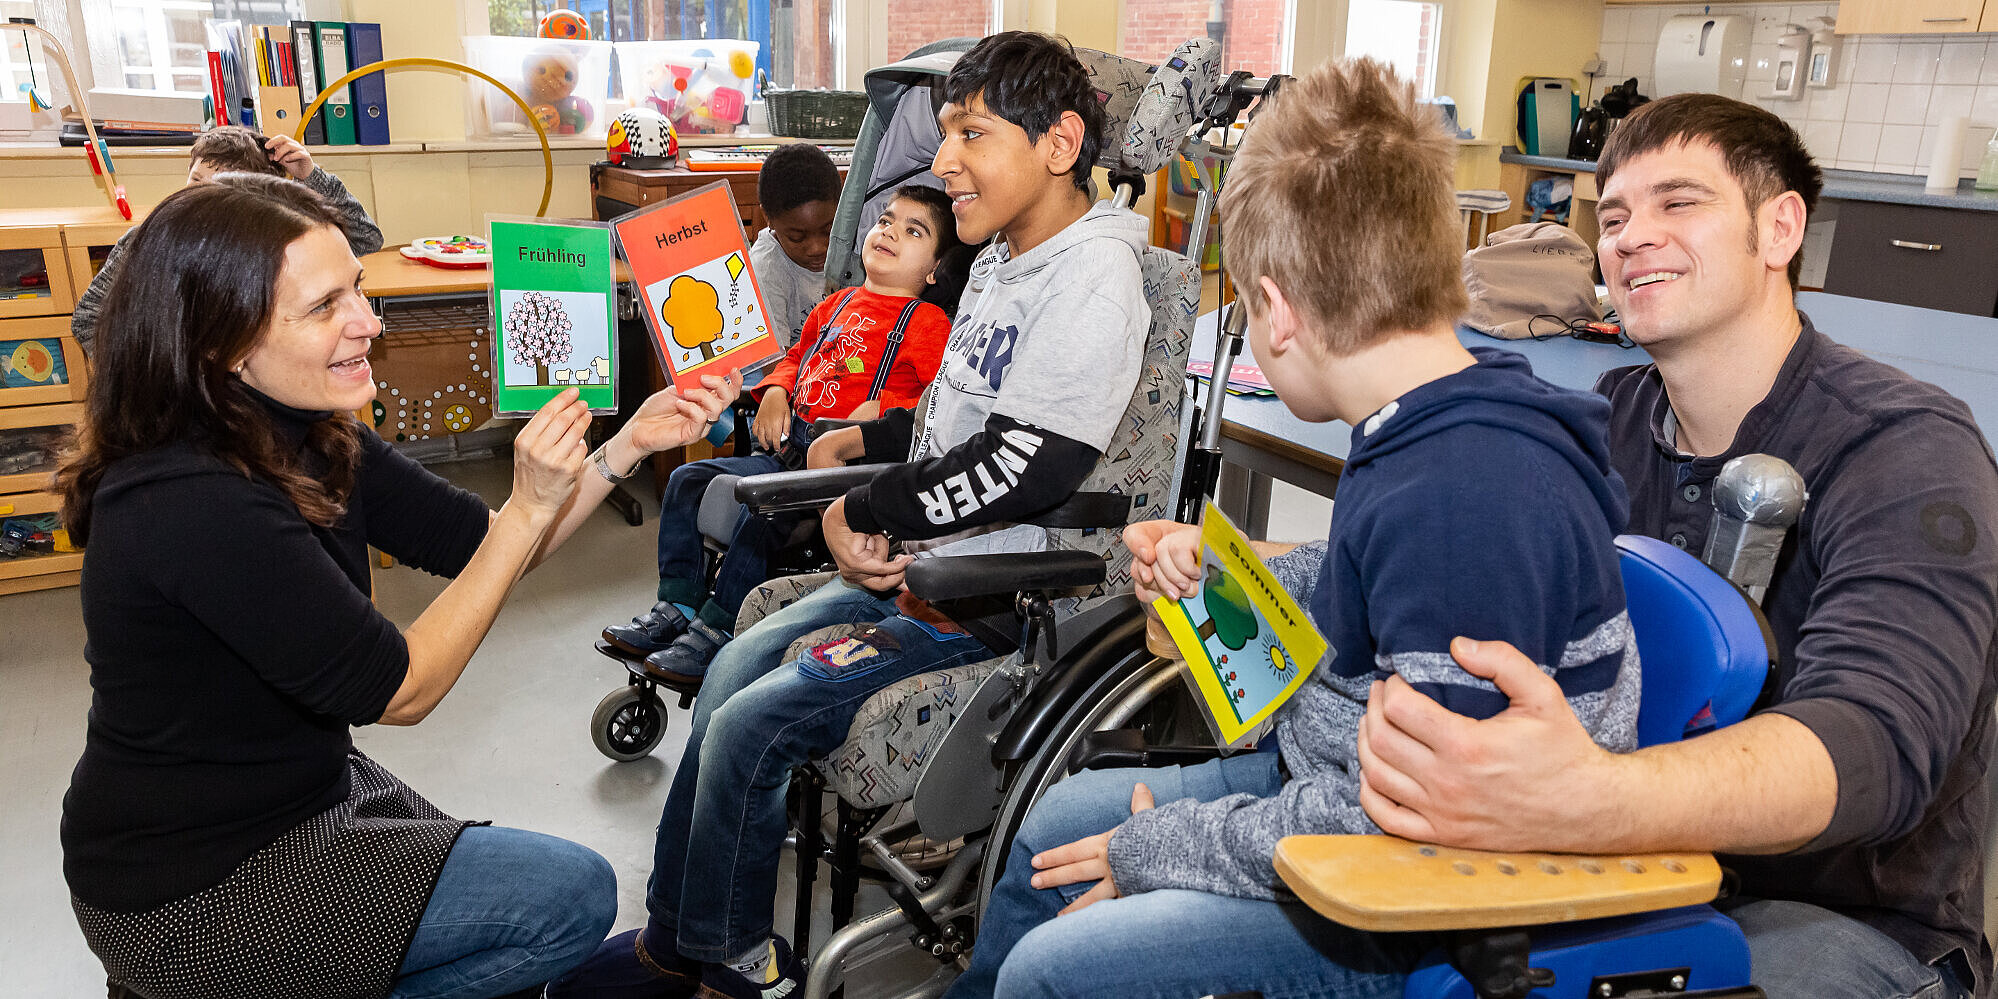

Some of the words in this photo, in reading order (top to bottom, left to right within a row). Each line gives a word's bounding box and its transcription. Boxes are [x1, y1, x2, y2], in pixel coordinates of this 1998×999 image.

[655, 219, 709, 250] Herbst
[518, 246, 587, 268] Frühling
[975, 255, 998, 269] LEAGUE
[928, 385, 940, 420] CHAMPION
[936, 360, 949, 385] LEAGUE
[920, 426, 933, 450] LEAGUE
[917, 418, 1044, 525] UNTER
[1229, 542, 1297, 627] Sommer
